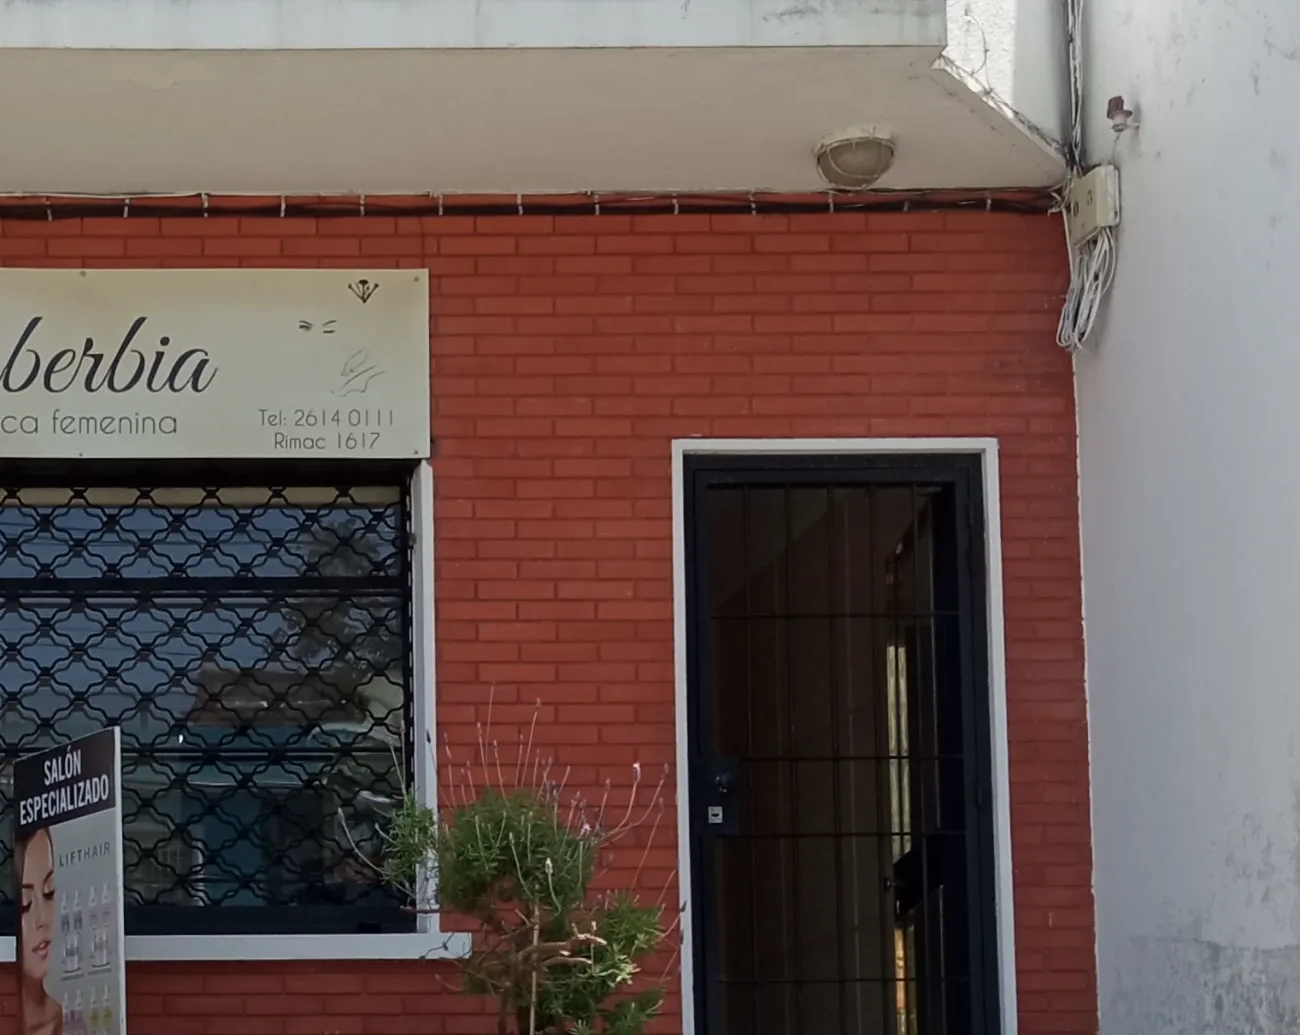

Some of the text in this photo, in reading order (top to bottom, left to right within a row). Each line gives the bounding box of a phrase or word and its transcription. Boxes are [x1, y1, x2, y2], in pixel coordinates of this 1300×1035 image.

[52, 409, 177, 434] femenina
[294, 408, 341, 427] 2614
[348, 408, 393, 427] 0111
[274, 432, 381, 449] Rimac 1617
[43, 745, 82, 786] SALÓN
[20, 774, 109, 826] ESPECIALIZADO
[58, 842, 111, 867] LIFTHAIR
